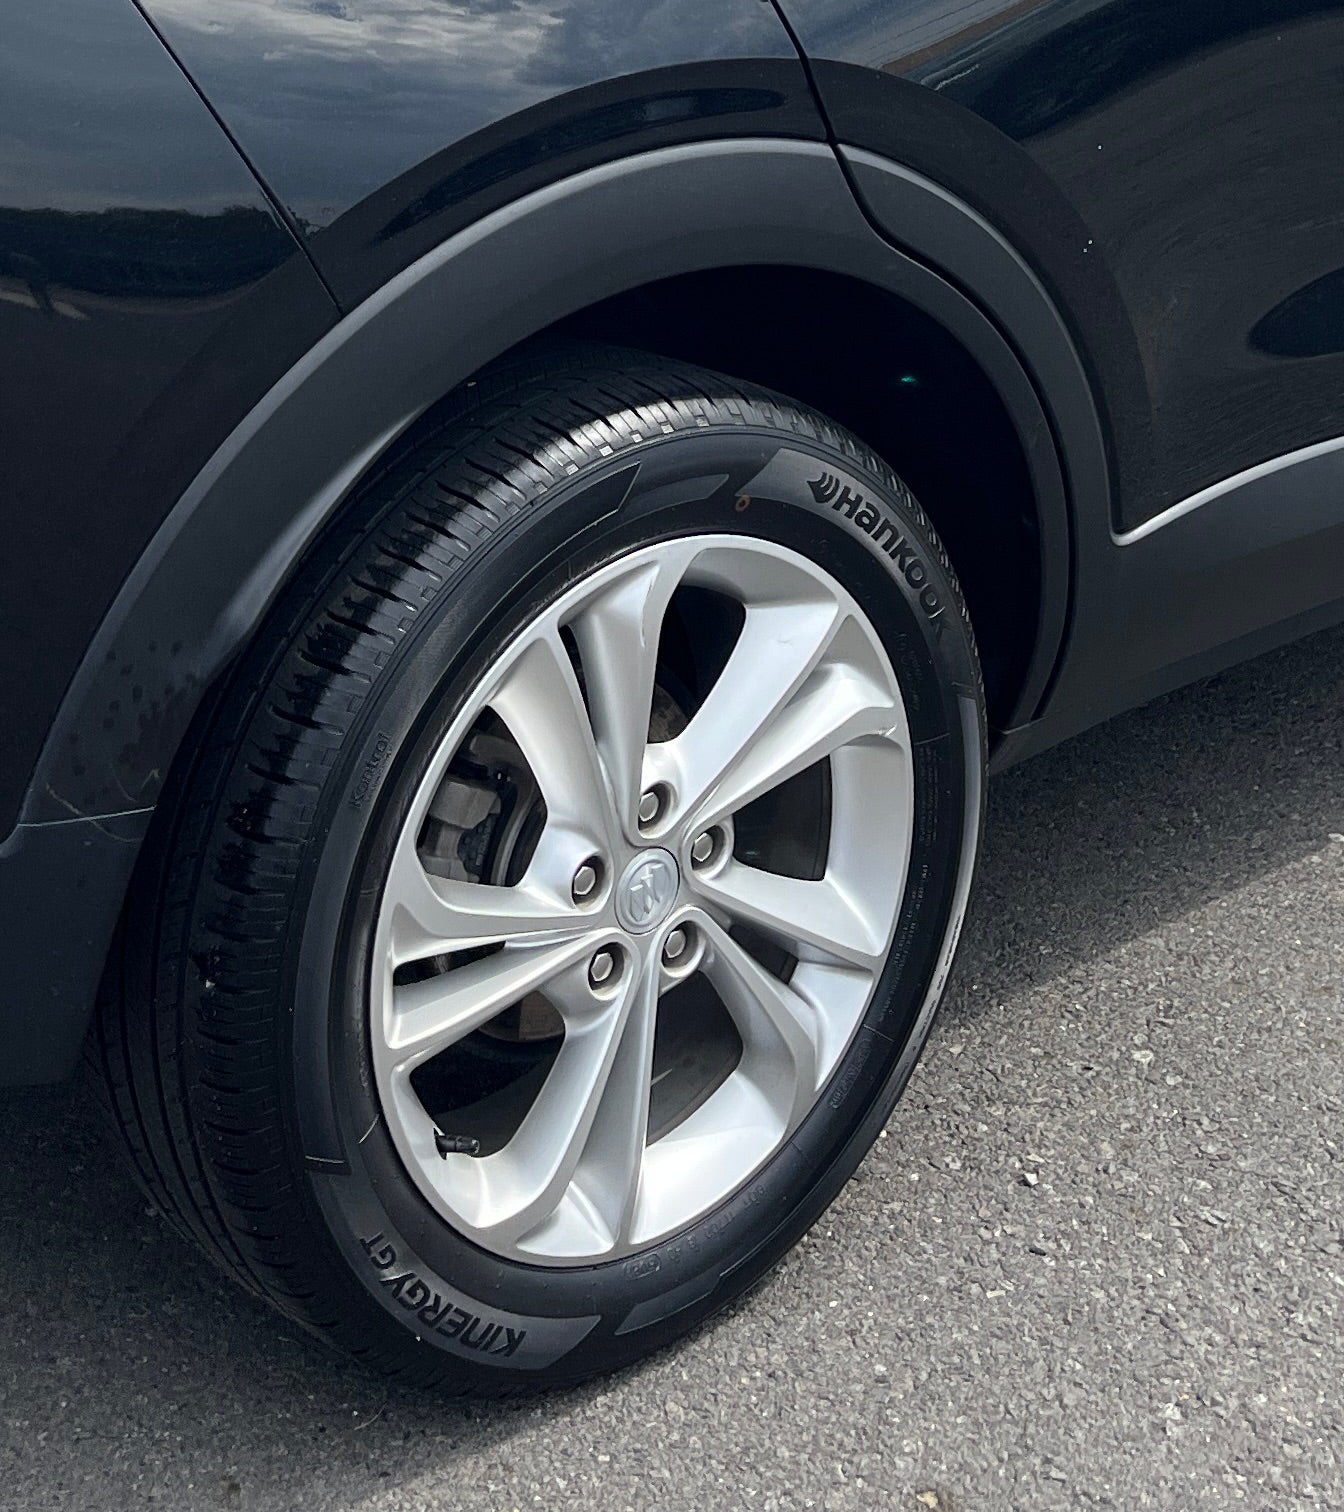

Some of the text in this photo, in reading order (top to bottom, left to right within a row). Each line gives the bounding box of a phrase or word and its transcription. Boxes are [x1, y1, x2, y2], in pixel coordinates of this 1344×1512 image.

[831, 485, 955, 643] Hankook
[360, 1231, 527, 1357] KINERGY GT
